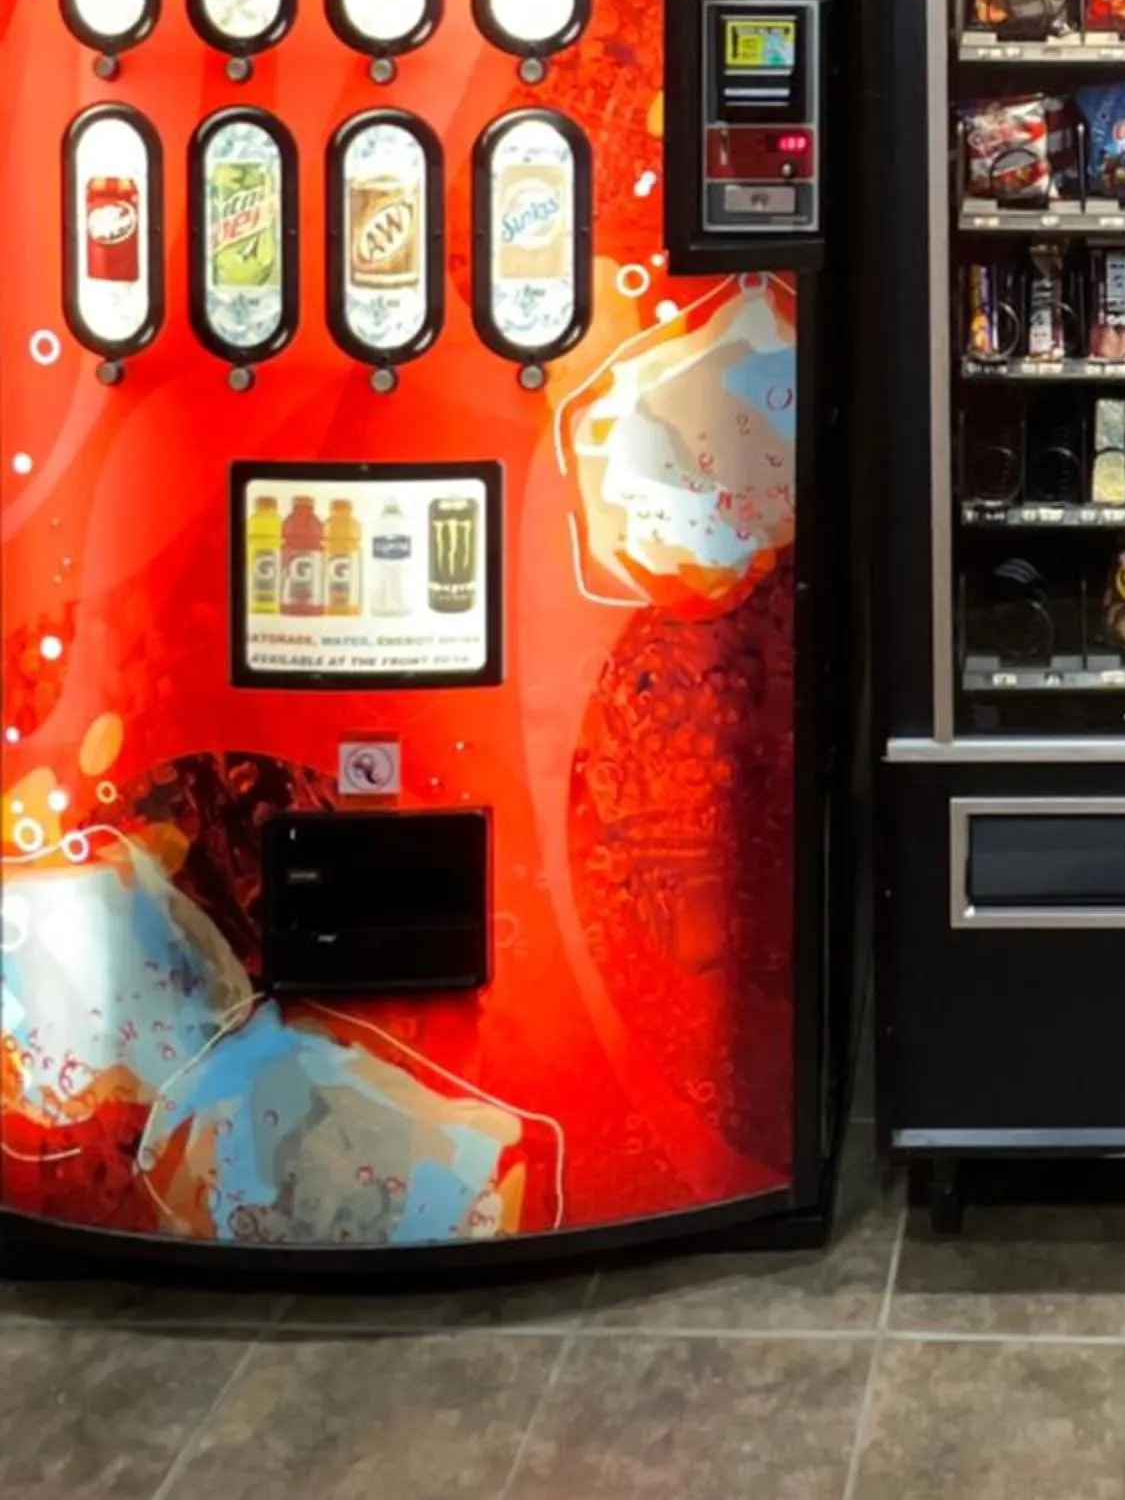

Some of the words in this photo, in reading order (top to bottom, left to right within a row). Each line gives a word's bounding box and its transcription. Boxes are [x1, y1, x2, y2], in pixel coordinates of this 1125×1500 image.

[251, 653, 323, 666] AVAILABLE
[328, 655, 345, 666] AT
[351, 656, 377, 666] THE
